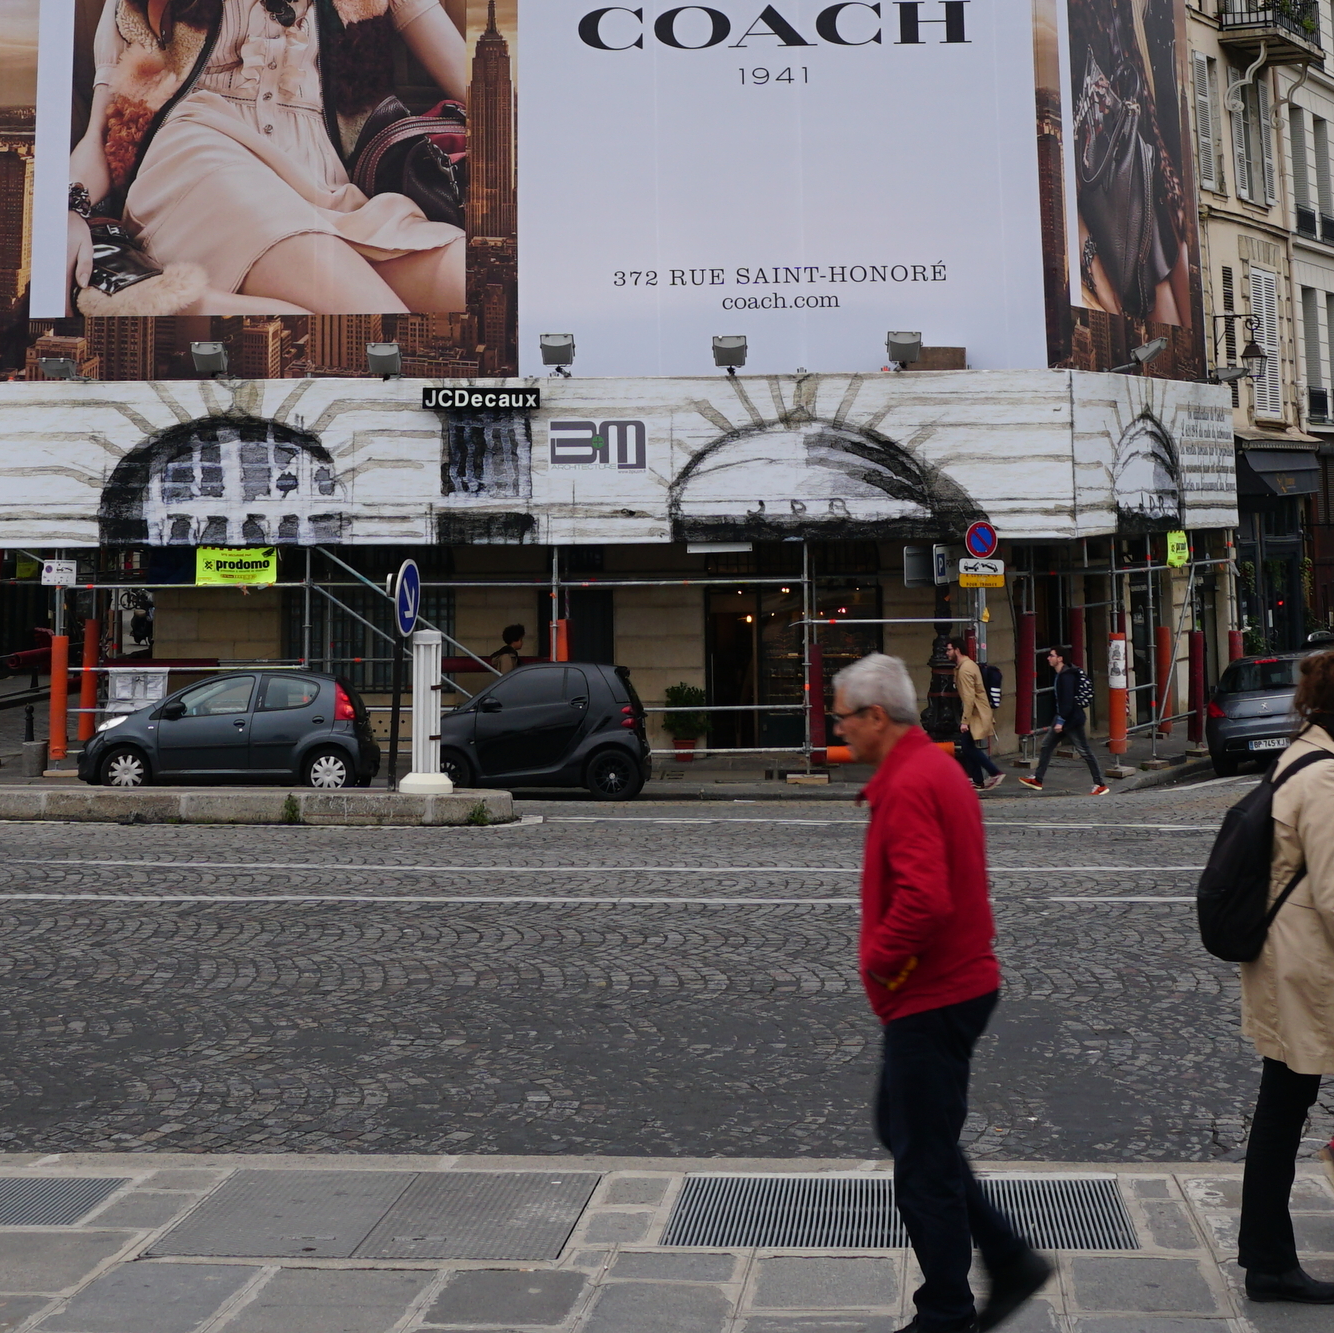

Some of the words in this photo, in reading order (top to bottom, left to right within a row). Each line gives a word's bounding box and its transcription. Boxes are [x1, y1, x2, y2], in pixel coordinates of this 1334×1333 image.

[578, 1, 972, 50] COACH
[739, 67, 809, 85] 1941
[613, 271, 658, 287] 372
[670, 269, 725, 286] RUE
[736, 259, 947, 285] SAINT-HONORÉ
[722, 292, 841, 310] coach.com
[425, 389, 537, 408] JCDecaux
[216, 559, 270, 571] prodomo
